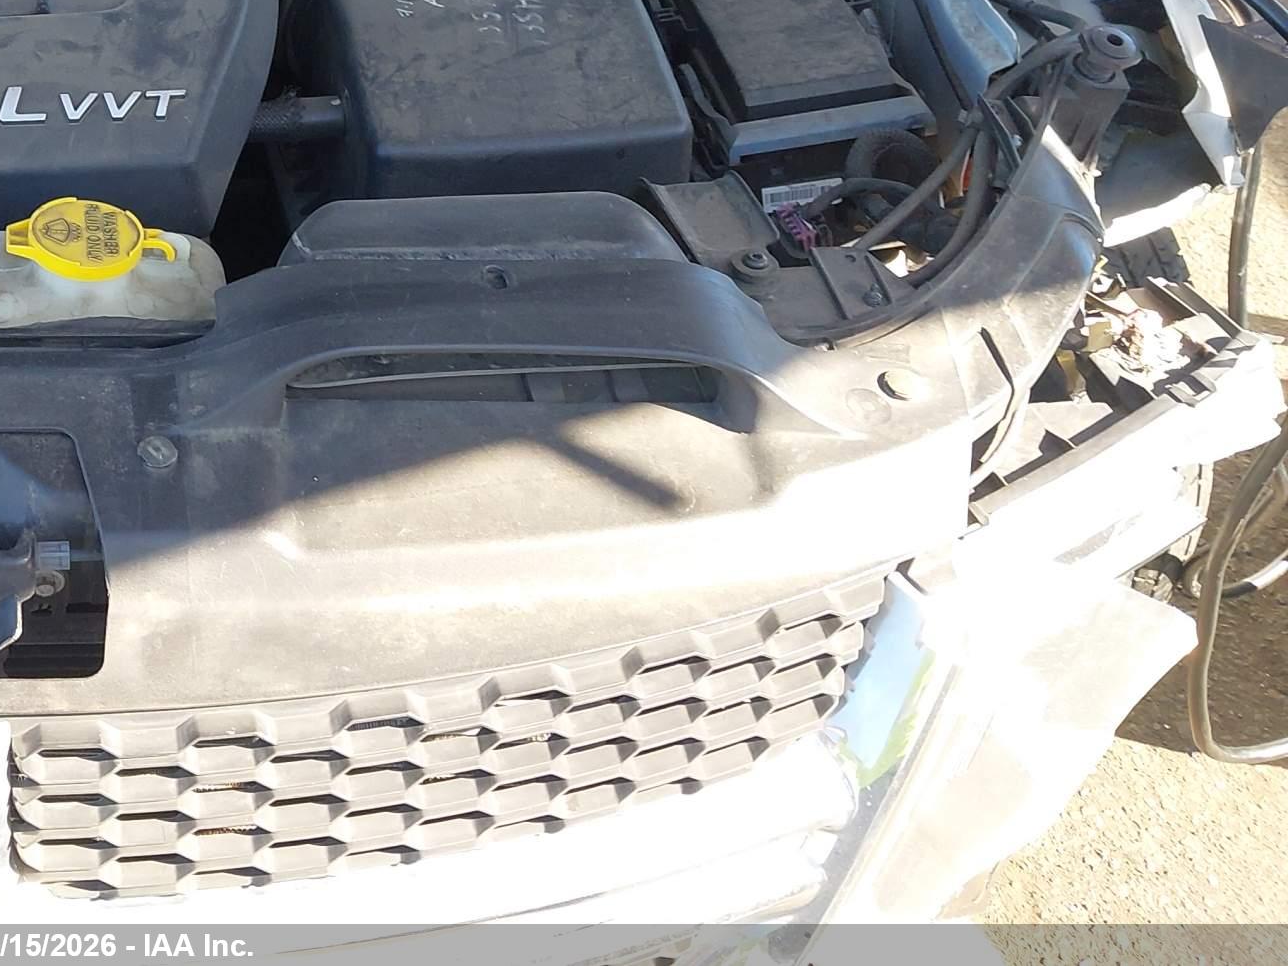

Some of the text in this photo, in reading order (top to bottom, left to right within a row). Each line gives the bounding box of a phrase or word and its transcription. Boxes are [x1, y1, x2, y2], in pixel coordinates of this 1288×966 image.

[60, 88, 187, 122] VVT
[85, 203, 104, 264] FLUID ONLY
[103, 211, 120, 258] WASHER
